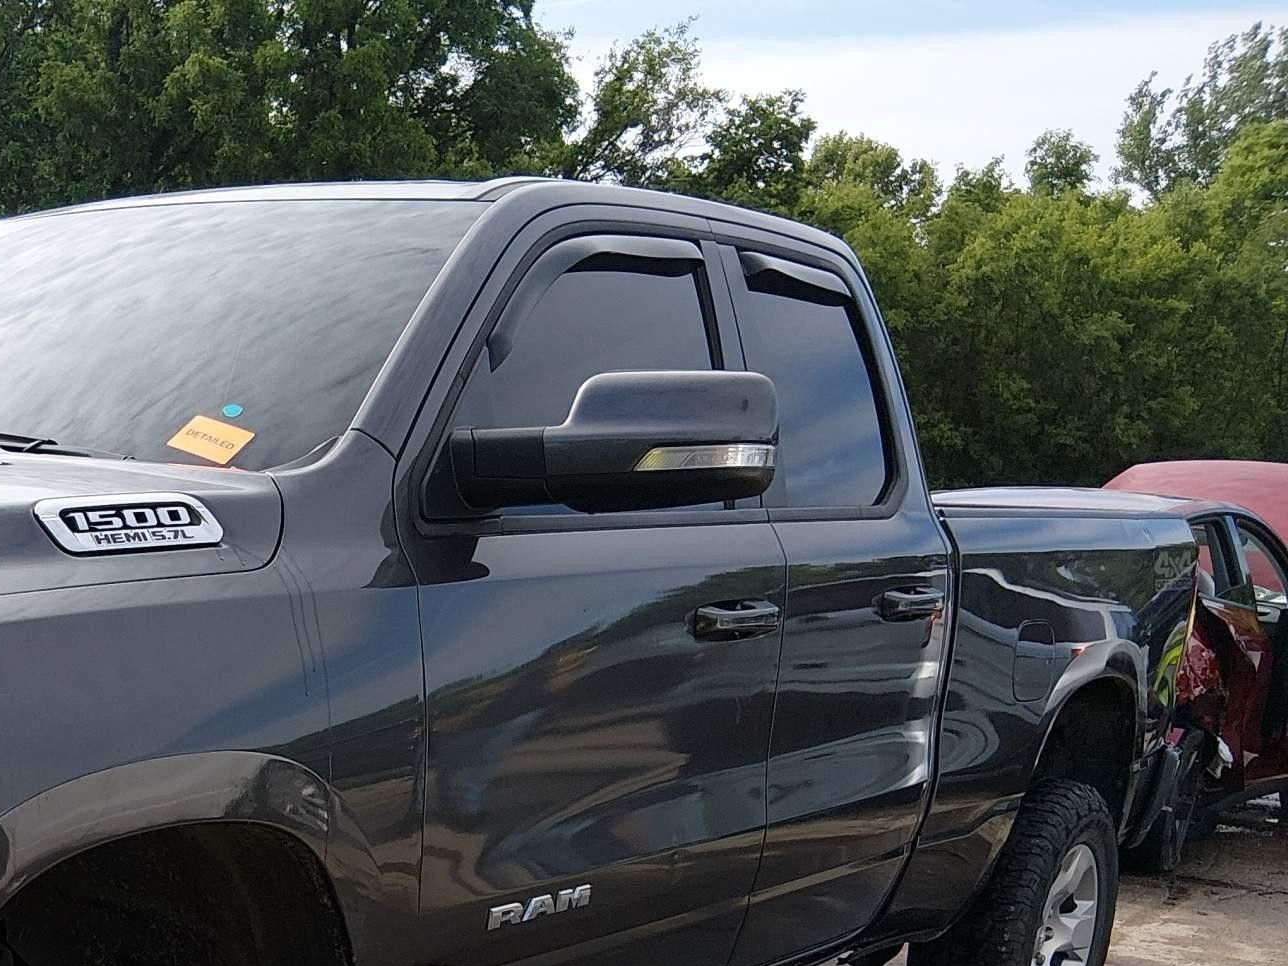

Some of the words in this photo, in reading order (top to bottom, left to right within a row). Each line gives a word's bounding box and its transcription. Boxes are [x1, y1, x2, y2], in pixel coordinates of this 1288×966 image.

[186, 429, 235, 450] DETAILED
[65, 506, 193, 531] 1500
[95, 530, 149, 546] HEMI
[151, 529, 196, 542] 5.7L
[487, 884, 592, 931] RAM
